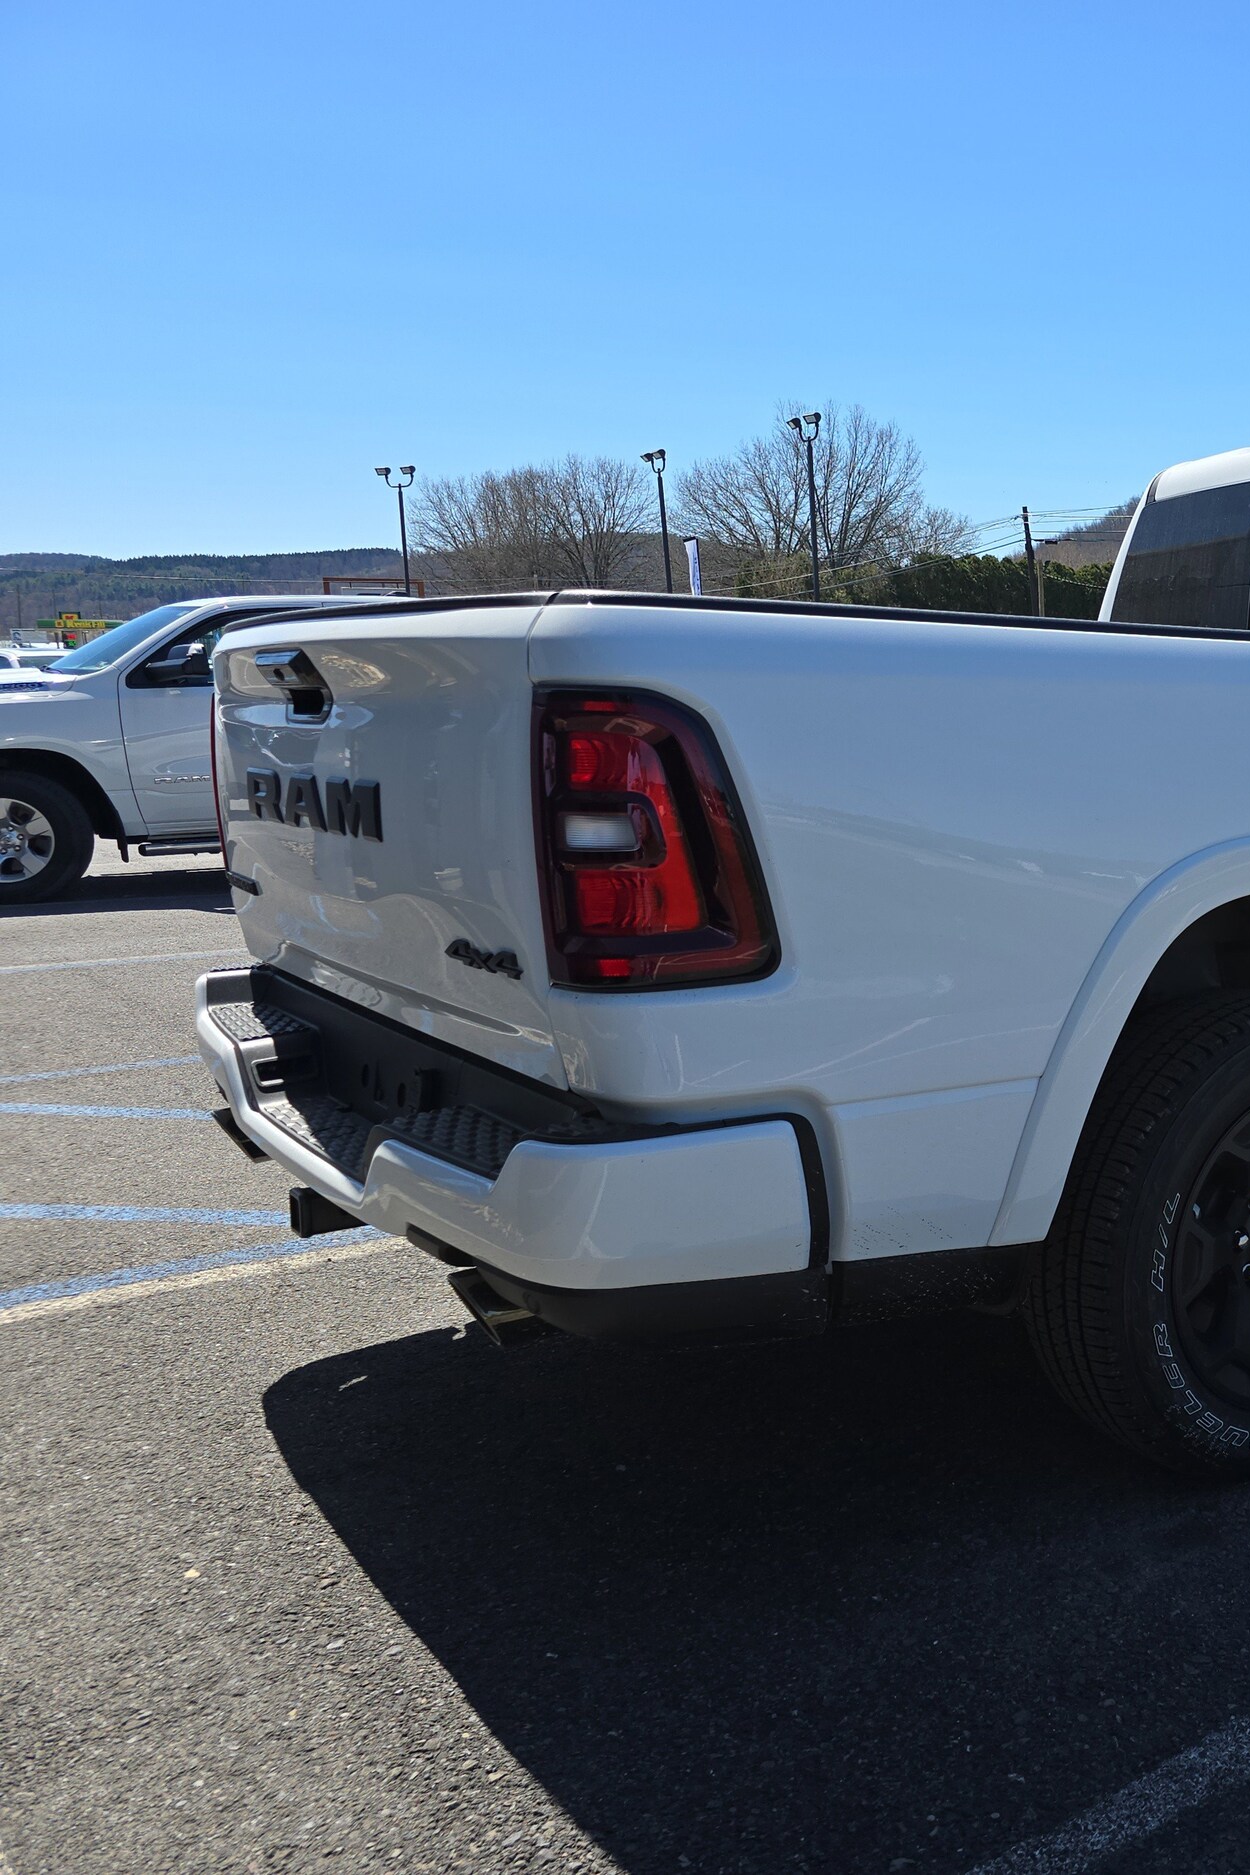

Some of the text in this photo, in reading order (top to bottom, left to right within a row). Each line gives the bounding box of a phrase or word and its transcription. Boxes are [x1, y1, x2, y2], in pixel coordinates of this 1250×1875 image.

[154, 774, 210, 785] RAM
[246, 766, 383, 843] RAM
[1151, 1193, 1181, 1292] H/L
